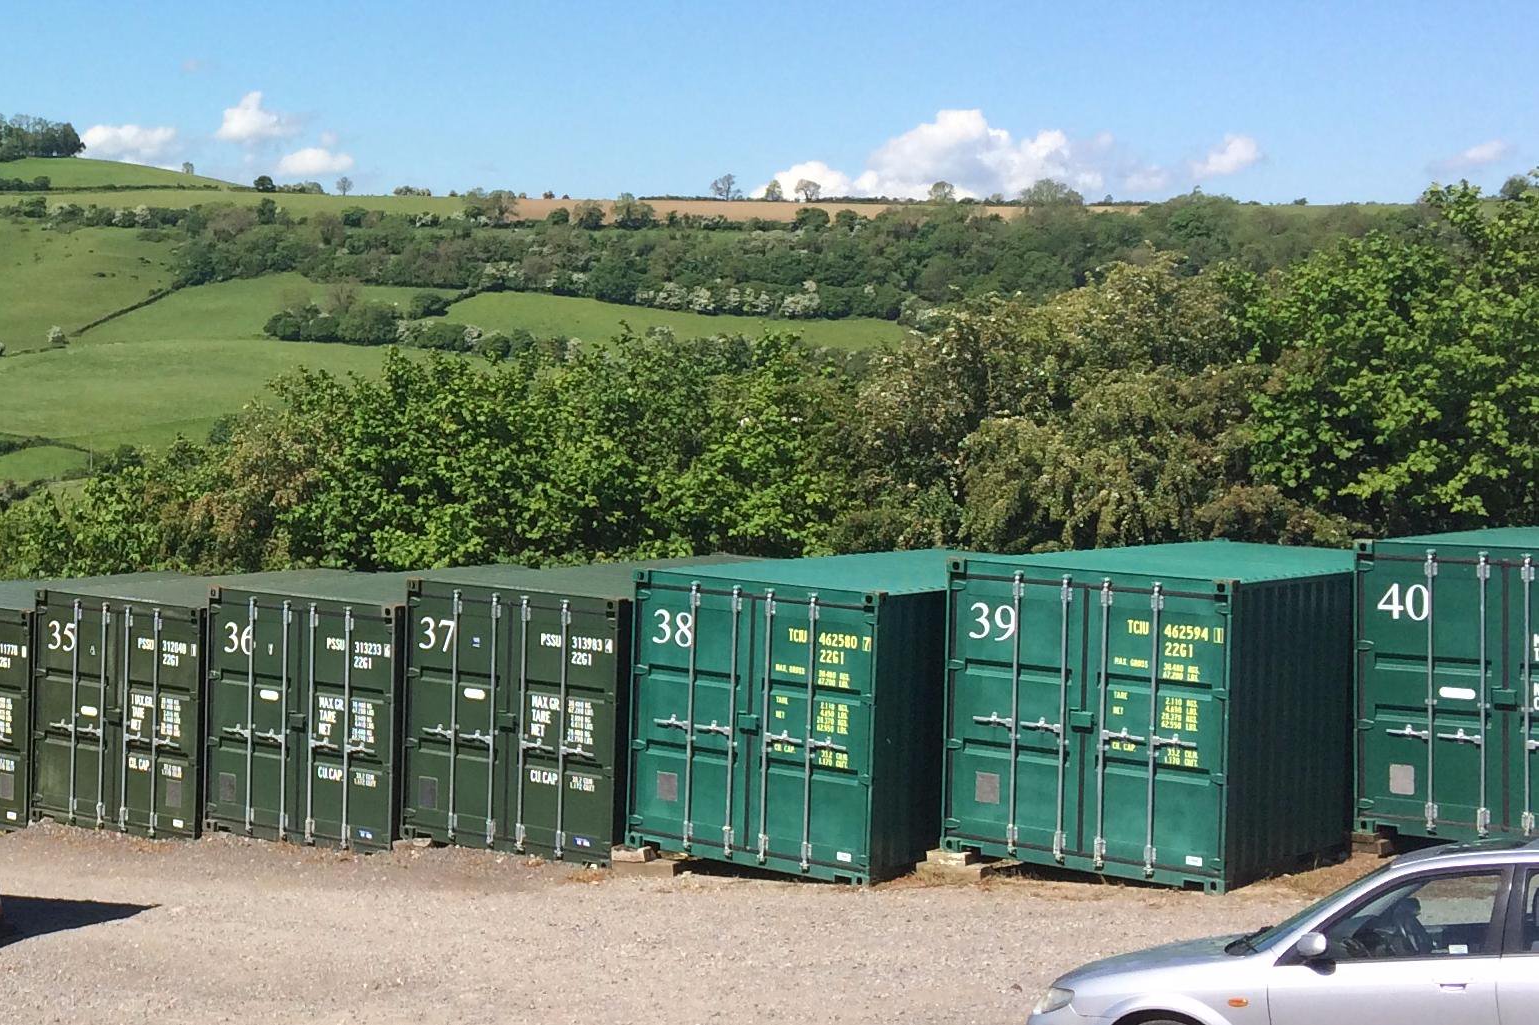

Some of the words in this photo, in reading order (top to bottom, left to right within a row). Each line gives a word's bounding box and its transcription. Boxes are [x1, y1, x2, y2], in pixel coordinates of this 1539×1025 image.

[1377, 582, 1429, 621] 40
[48, 620, 76, 652] 35
[224, 621, 257, 656] 36
[418, 616, 455, 653] 37
[652, 608, 693, 648] 38
[969, 602, 1016, 641] 39
[1126, 619, 1150, 635] TCIU
[1164, 623, 1209, 642] 462594
[818, 632, 858, 649] 462580
[1164, 641, 1194, 658] 22G1
